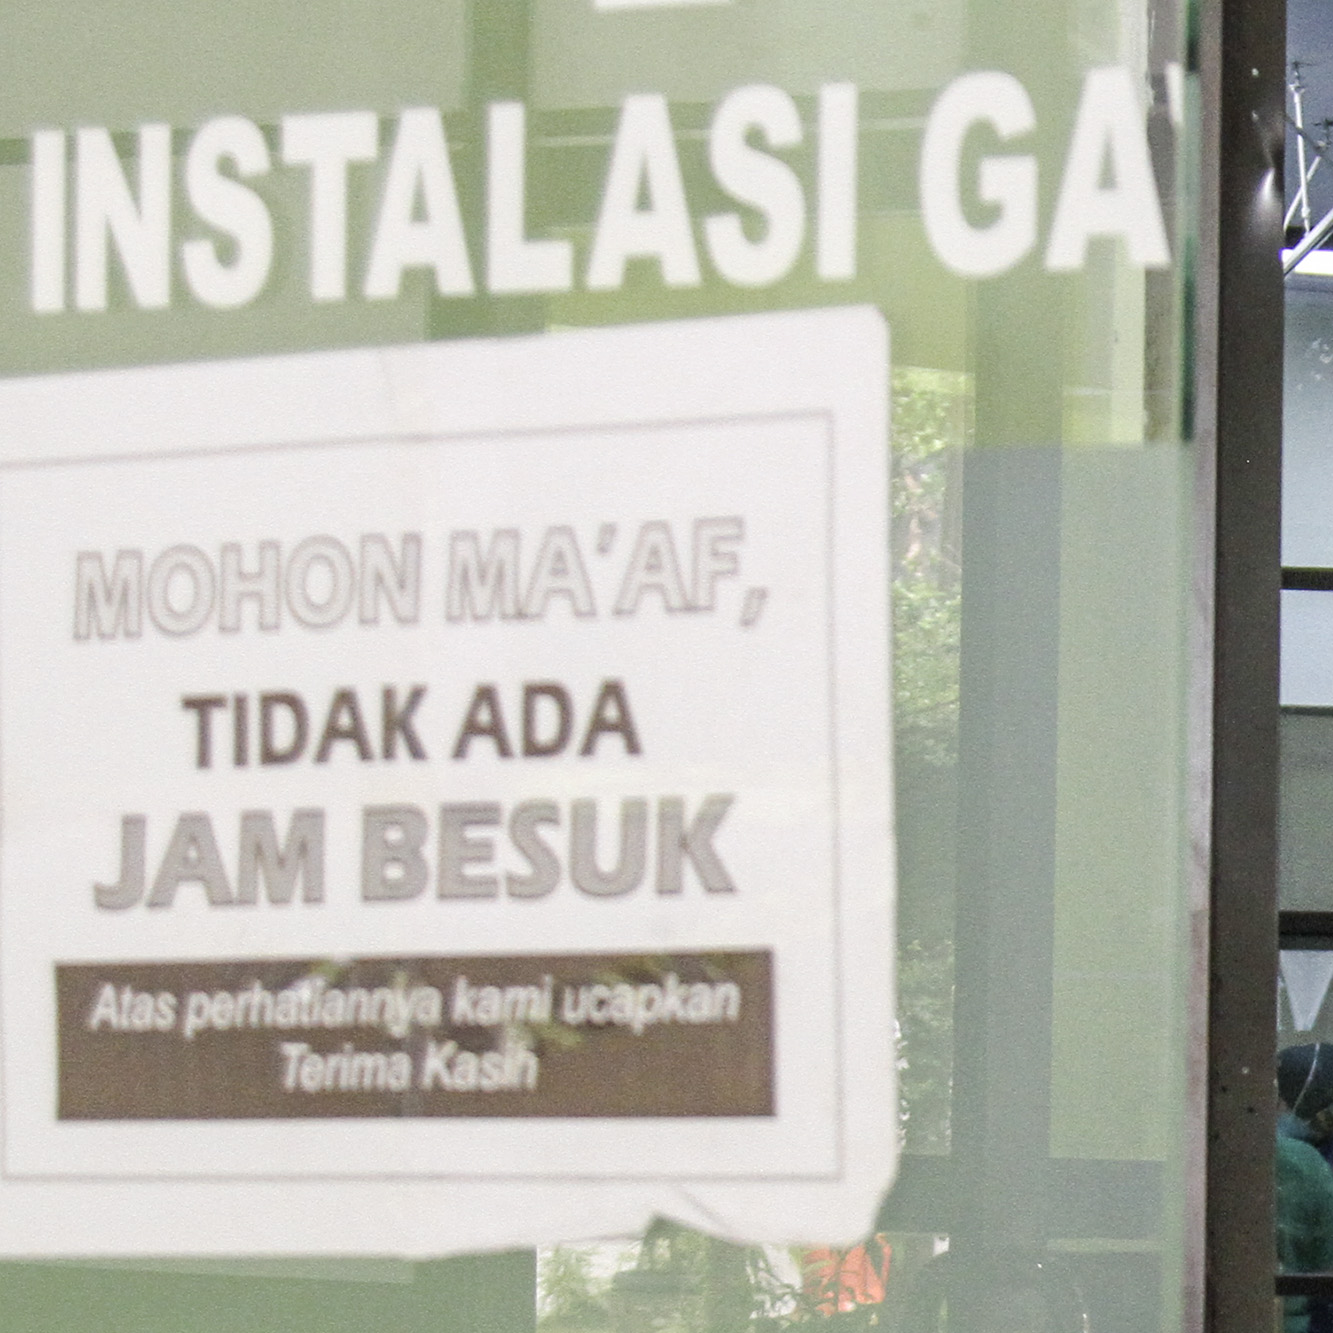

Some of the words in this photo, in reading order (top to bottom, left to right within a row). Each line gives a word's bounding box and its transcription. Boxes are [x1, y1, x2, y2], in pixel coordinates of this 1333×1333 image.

[31, 80, 859, 313] INSTALASI
[920, 63, 1184, 280] GA
[73, 531, 422, 641] MOHON
[444, 516, 769, 630] MA'AF,
[180, 682, 428, 769] TIDAK
[451, 676, 642, 760] ADA
[92, 805, 326, 912] JAM
[361, 793, 738, 903] BESUK
[88, 981, 177, 1031] Atas
[183, 975, 442, 1040] perhatiannya
[452, 974, 553, 1026] kami
[562, 972, 741, 1036] ucapkan
[279, 1041, 413, 1093] Terima
[422, 1039, 539, 1092] Kasih
